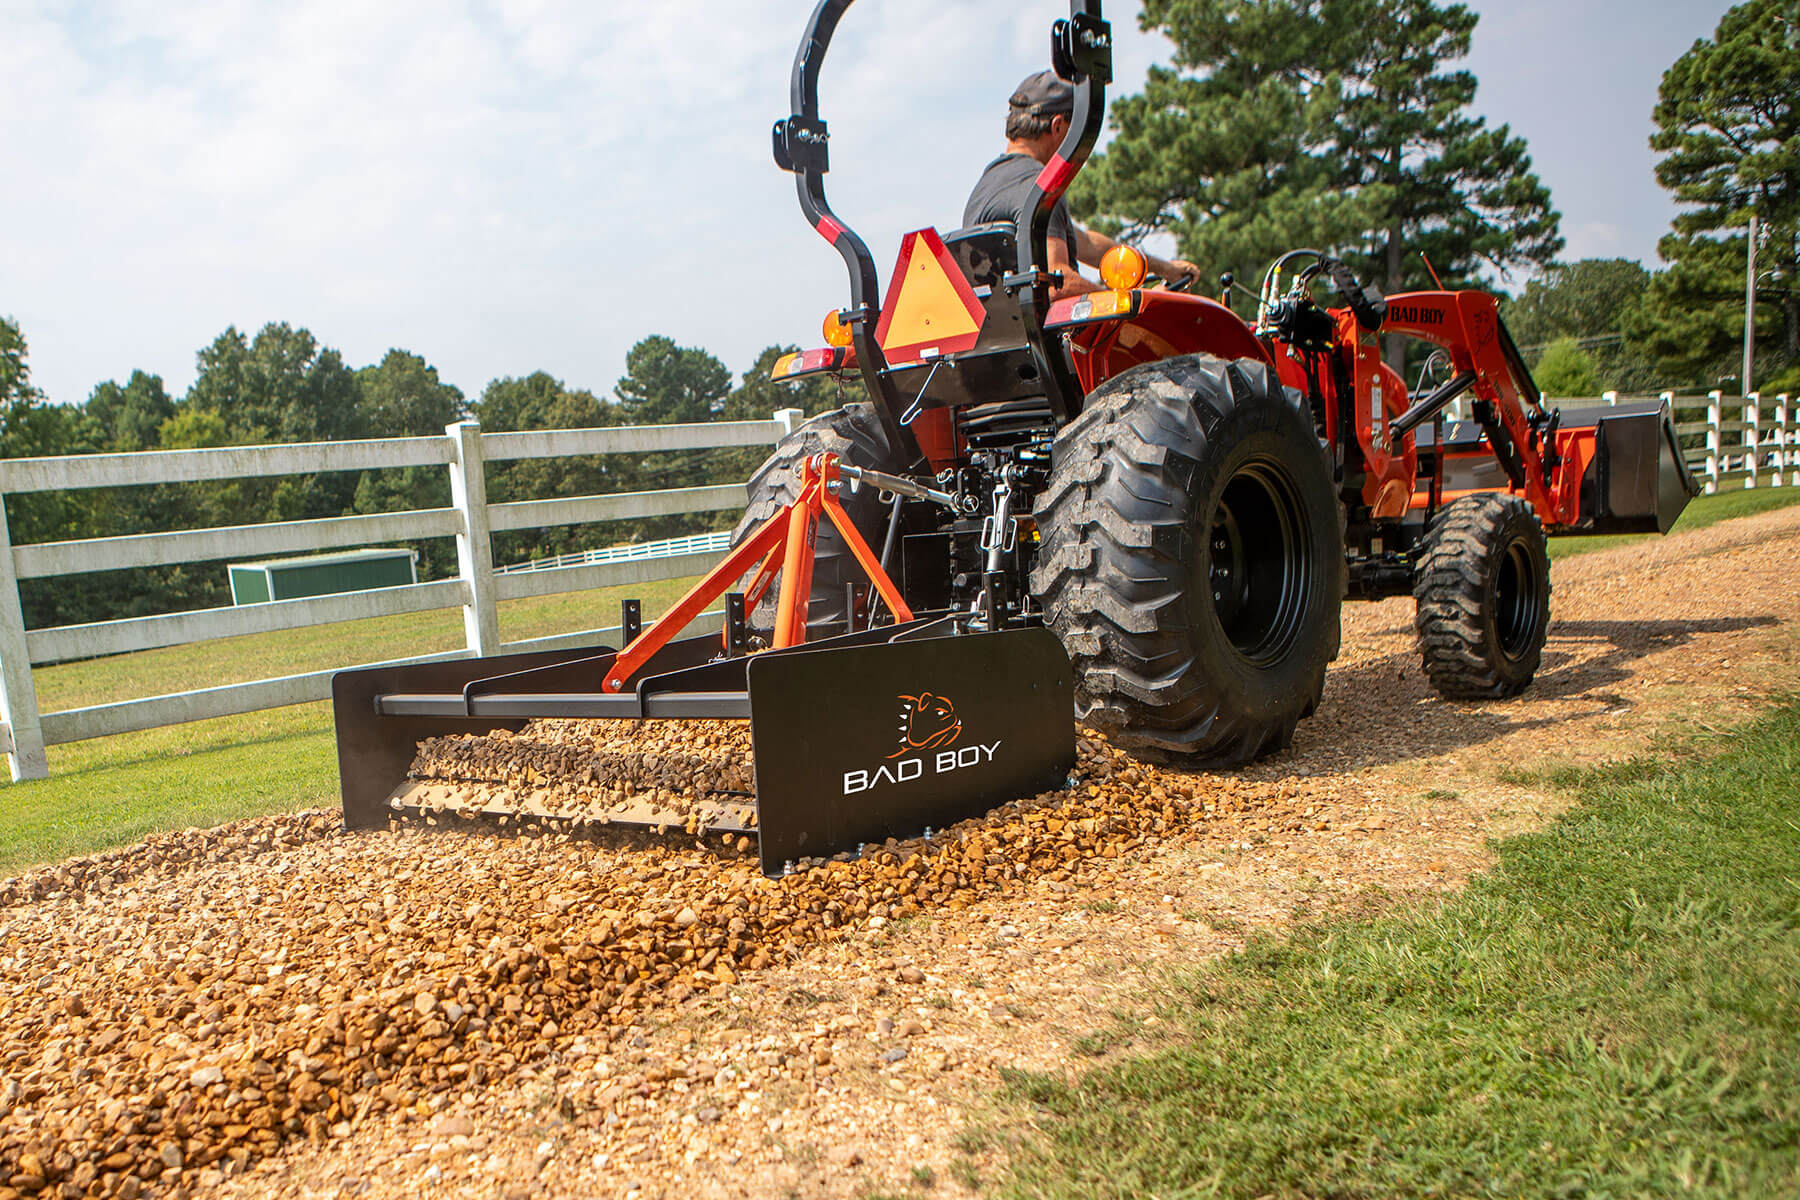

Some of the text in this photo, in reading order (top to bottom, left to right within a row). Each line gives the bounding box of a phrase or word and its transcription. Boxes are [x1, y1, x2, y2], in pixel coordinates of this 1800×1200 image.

[1390, 306, 1445, 325] BAD BOY
[843, 740, 1002, 795] BAD BOY
